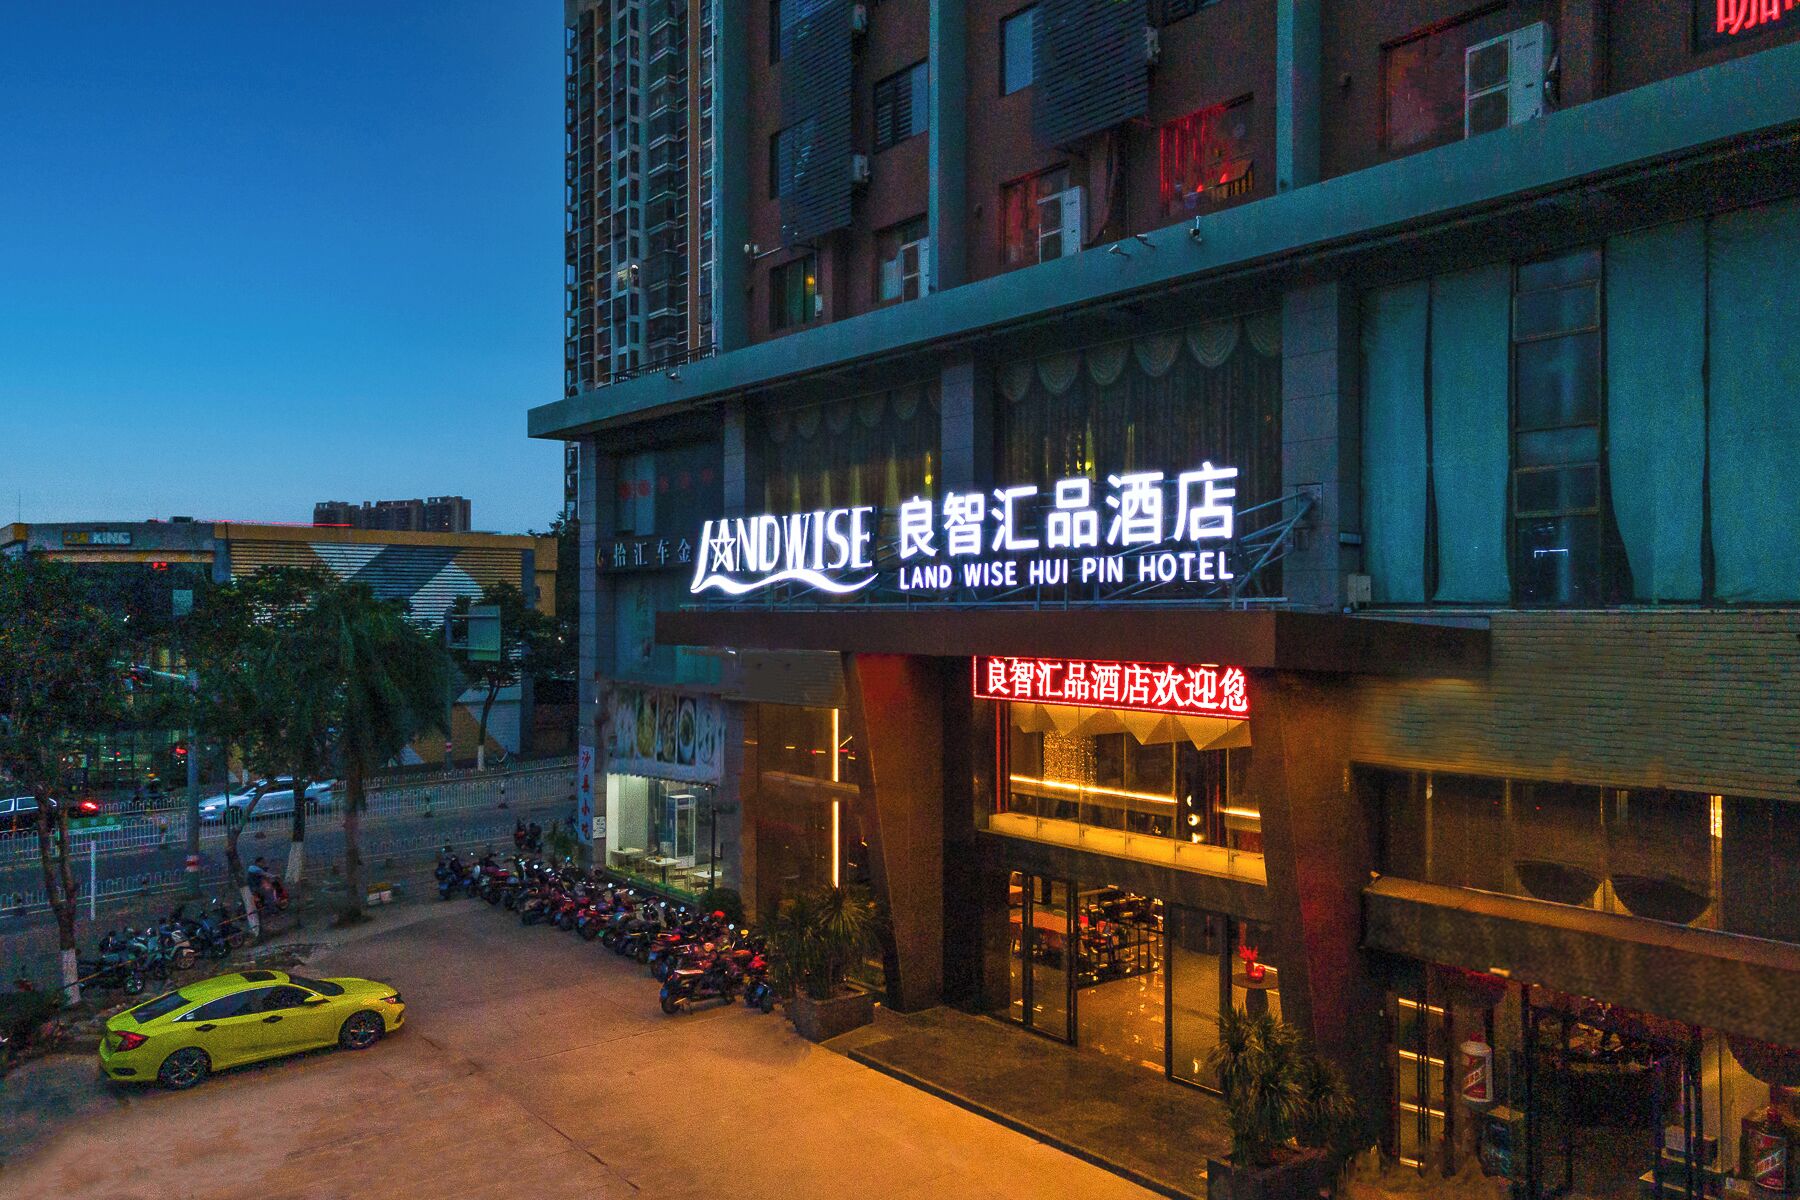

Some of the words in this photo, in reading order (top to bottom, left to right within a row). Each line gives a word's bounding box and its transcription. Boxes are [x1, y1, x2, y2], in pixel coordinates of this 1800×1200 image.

[900, 461, 1238, 559] 良智汇品酒店
[691, 506, 878, 593] LANDWISE
[900, 565, 952, 590] LAND
[964, 560, 1017, 586] WISE
[1029, 558, 1068, 584] HUI
[1082, 556, 1123, 583] PIN
[1139, 551, 1234, 582] HOTEL
[986, 657, 1249, 713] 良智汇品酒店欢迎您
